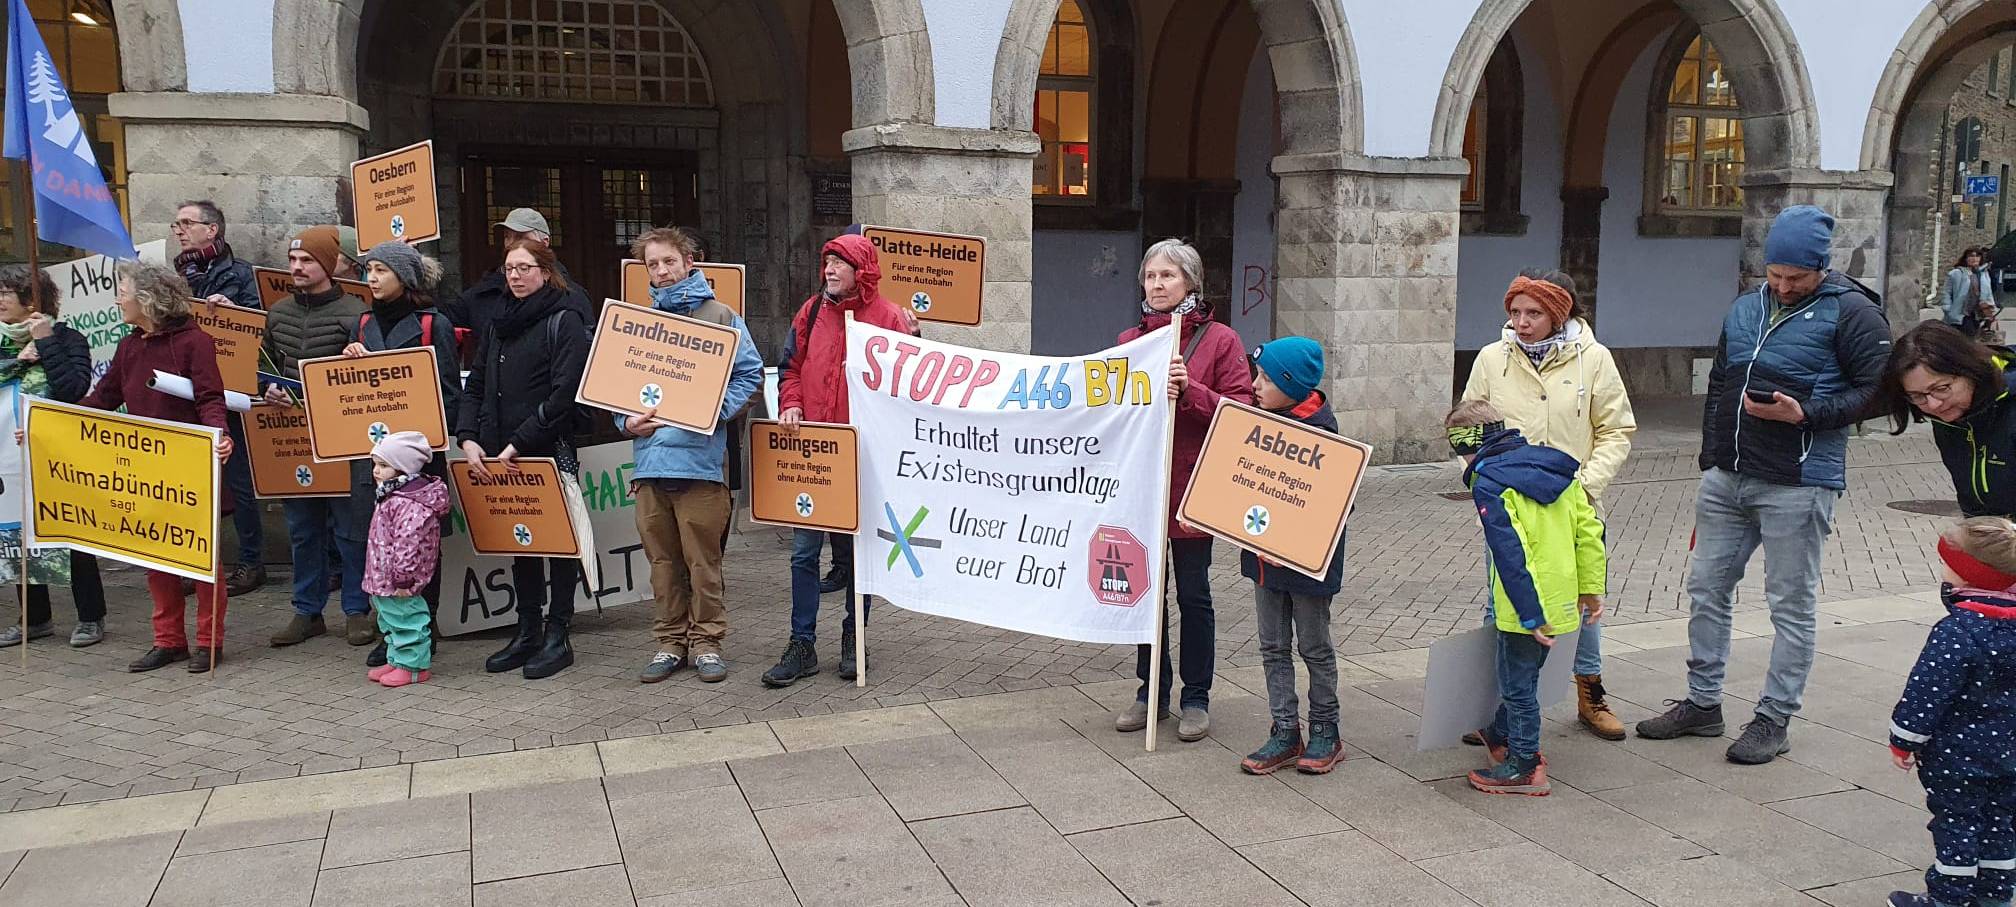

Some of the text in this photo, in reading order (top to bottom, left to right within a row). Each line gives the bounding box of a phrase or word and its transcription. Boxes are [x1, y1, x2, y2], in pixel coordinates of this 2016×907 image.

[370, 161, 416, 184] Oesbern
[374, 184, 414, 200] Für eine Region
[375, 196, 415, 211] ohne Autobahn
[870, 236, 977, 262] Platte-Heide
[71, 256, 121, 298] A46/
[892, 262, 953, 277] Für eine Region
[892, 274, 953, 287] ohne Autobahn
[1242, 264, 1271, 315] B
[64, 306, 122, 330] ÖKOLOGI
[192, 312, 264, 339] hofskamp
[213, 337, 236, 347] egion
[611, 313, 725, 357] Landhausen
[627, 346, 696, 370] Für eine Region
[326, 364, 413, 388] Hüingsen
[624, 359, 692, 383] ohne Autobahn
[862, 336, 1152, 410] STOPP A46 B7n
[339, 389, 407, 404] Für eine Region
[256, 411, 307, 429] Stübec
[342, 402, 408, 416] ohne Autobahn
[80, 420, 166, 456] Menden
[769, 432, 839, 458] Böingsen
[915, 417, 1101, 456] Erhaltet unsere
[1244, 425, 1326, 470] Asbeck
[116, 453, 131, 467] im
[776, 460, 831, 474] Für eine Region
[48, 459, 198, 507] Klimabündnis
[777, 472, 832, 486] ohne Autobahn
[896, 450, 1120, 504] Existensgrundlage
[1237, 456, 1312, 493] Für eine Region
[485, 495, 540, 505] Für eine Region
[1232, 473, 1306, 509] ohne Autobahn
[110, 499, 137, 514] sagt
[489, 507, 543, 515] ohne Autobahn
[39, 501, 208, 554] NEIN zu A46/B7n
[950, 506, 1072, 548] Unser Land
[955, 554, 1067, 590] euer Brot
[1102, 578, 1128, 592] STOPP
